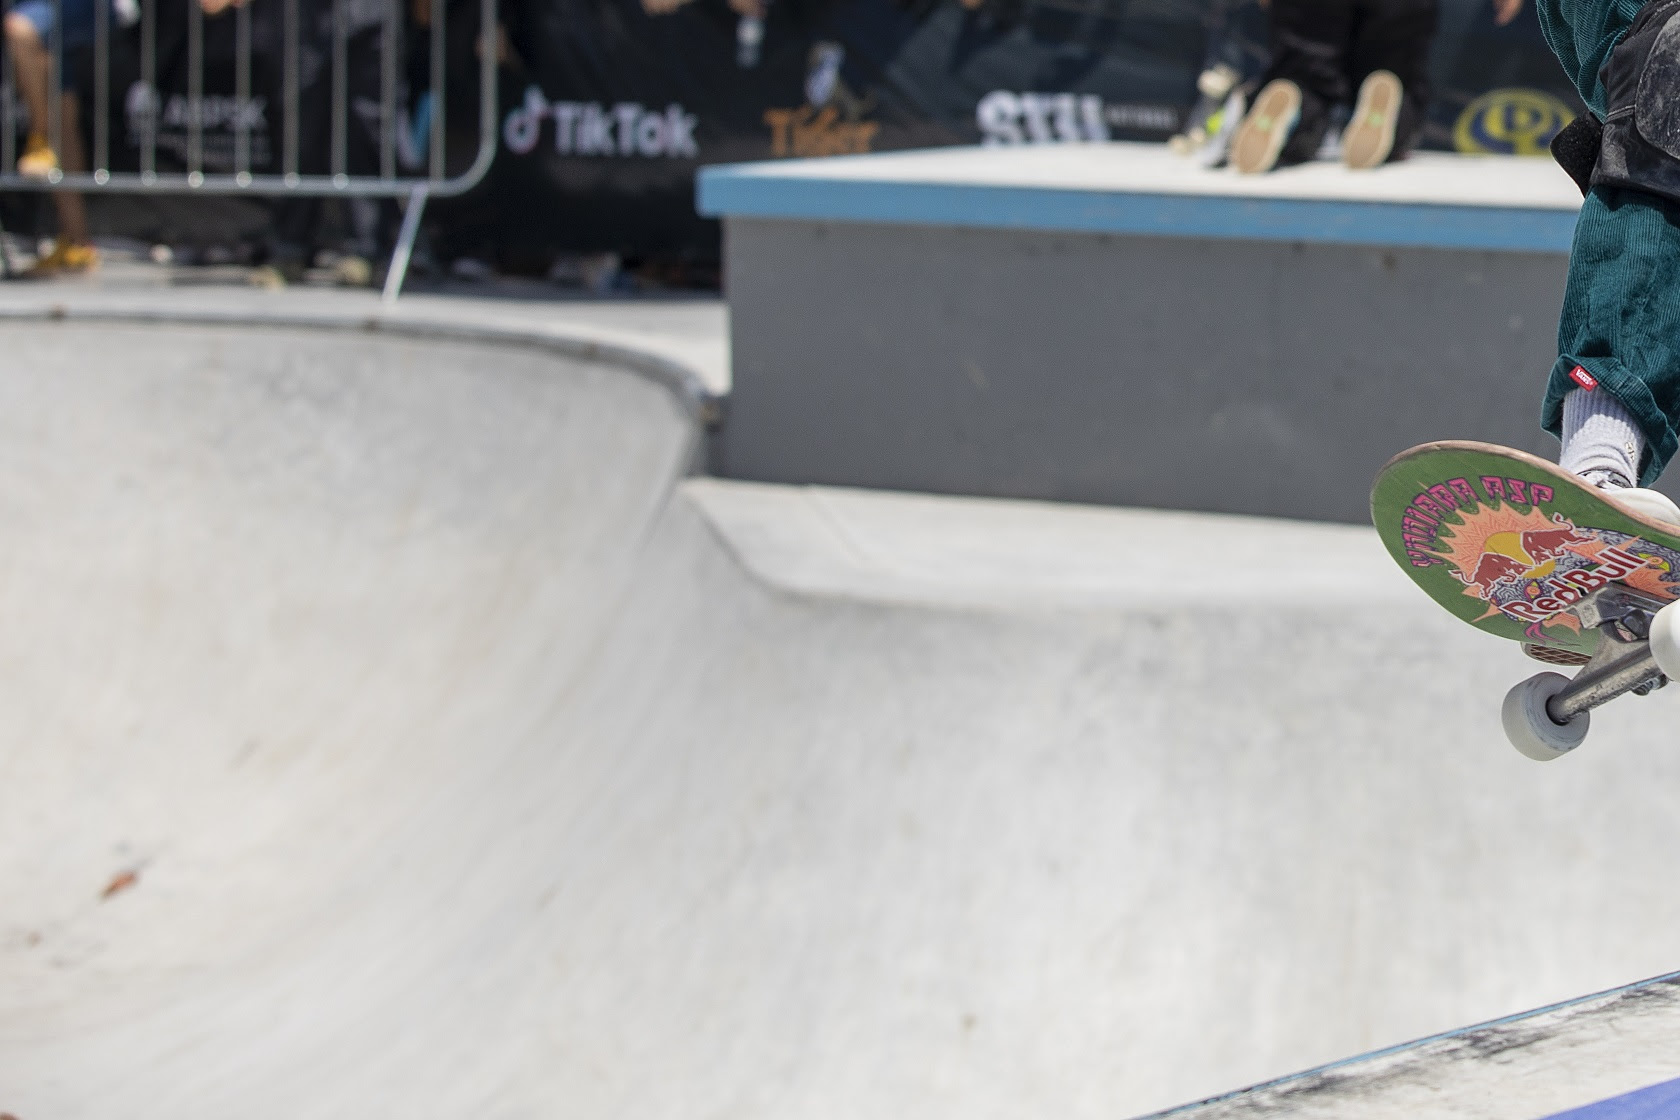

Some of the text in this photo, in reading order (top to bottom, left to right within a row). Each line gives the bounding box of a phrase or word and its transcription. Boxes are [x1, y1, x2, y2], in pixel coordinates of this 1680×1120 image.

[551, 100, 698, 158] TikTok
[1501, 546, 1648, 622] Red Bull
